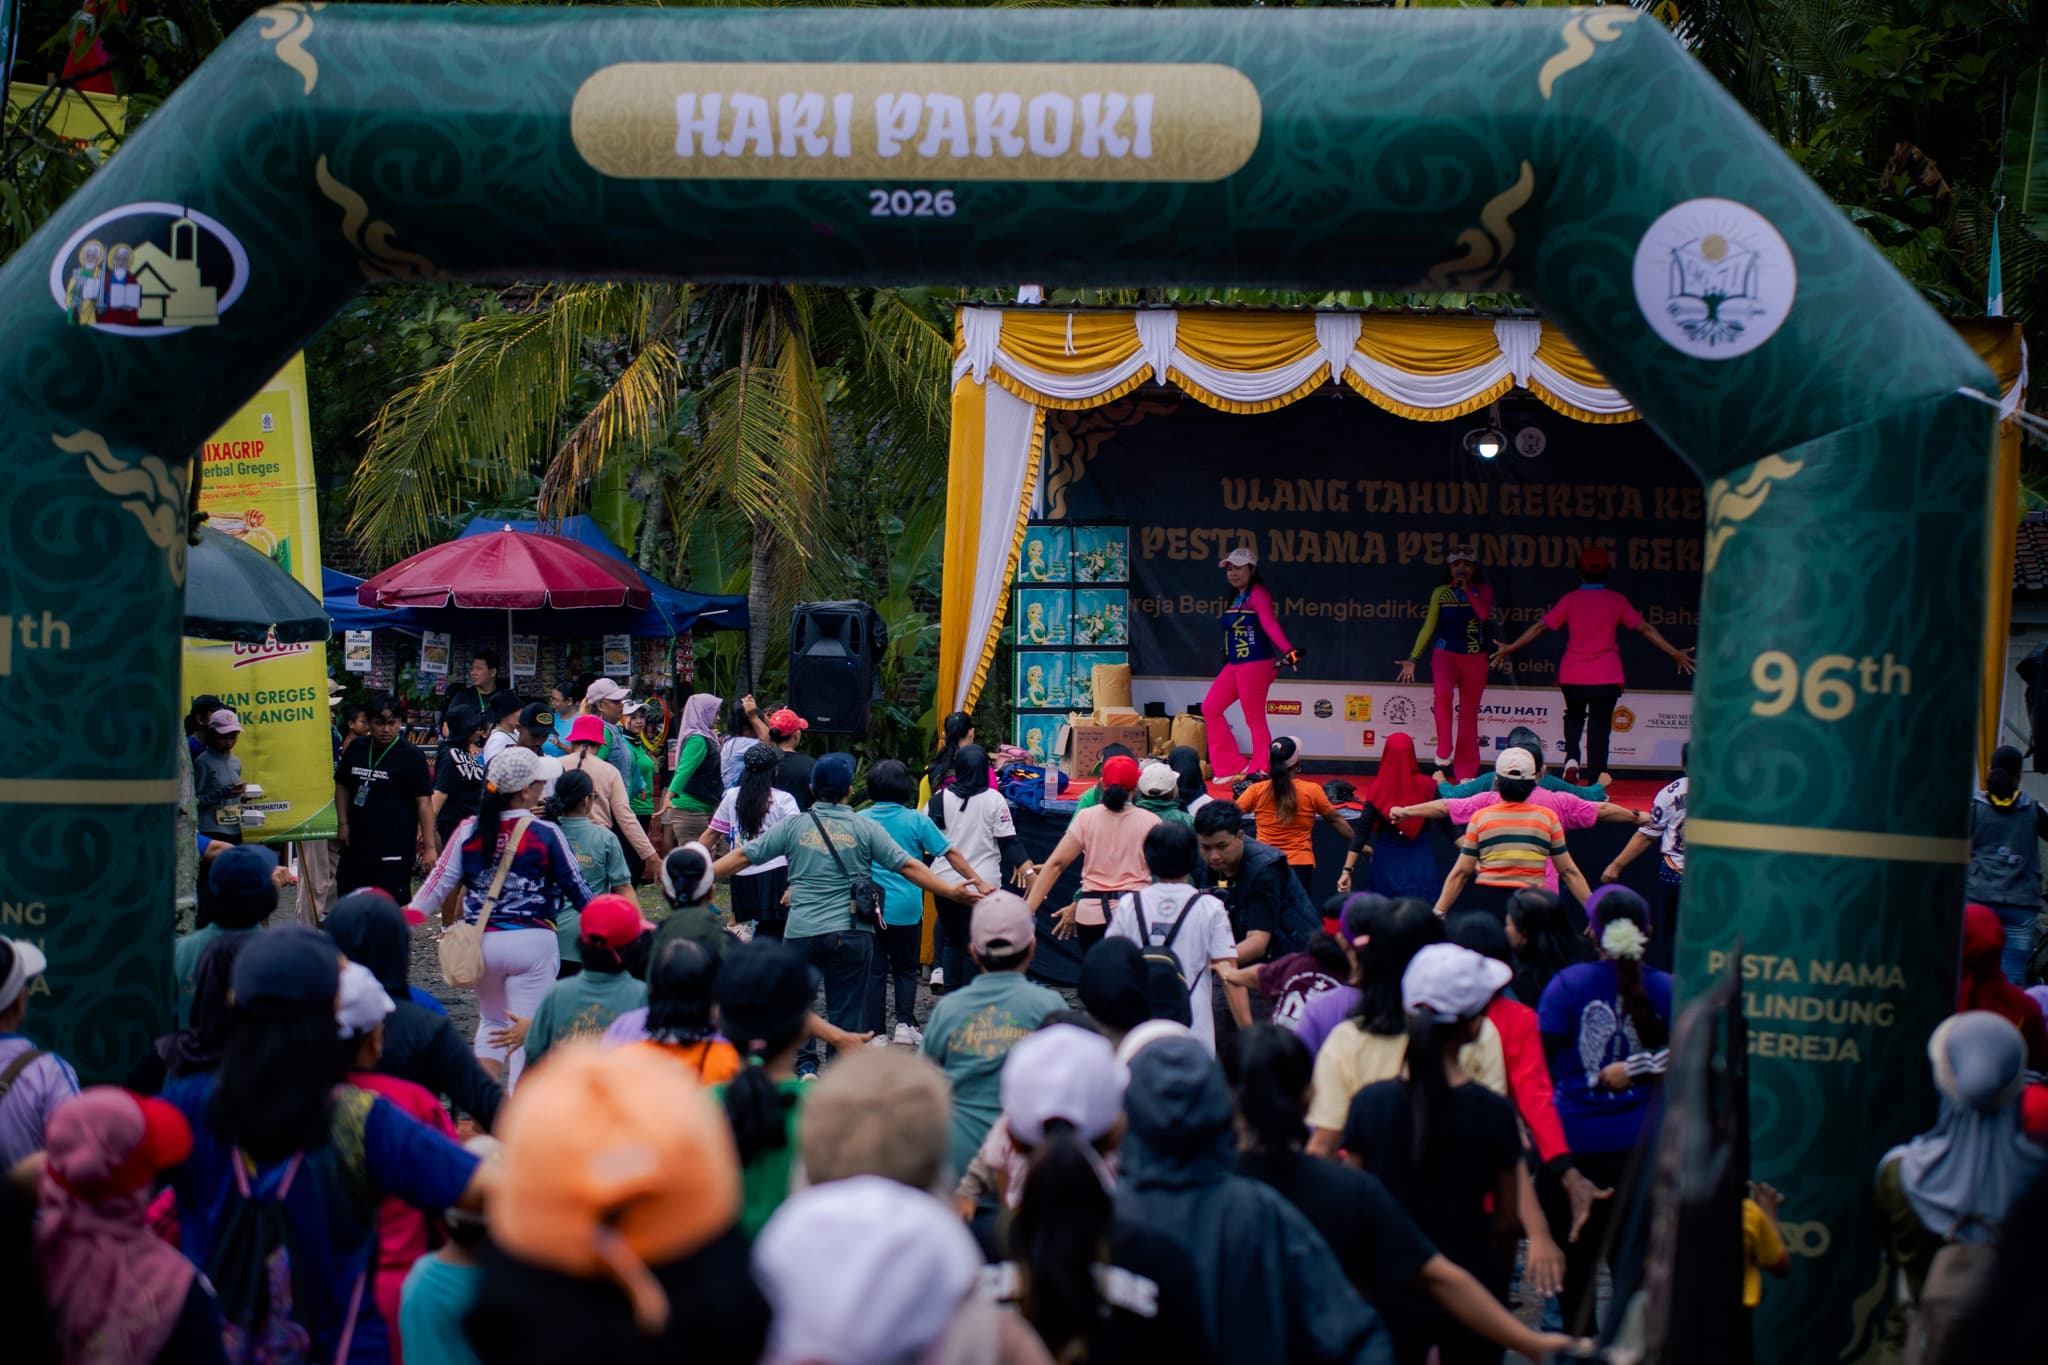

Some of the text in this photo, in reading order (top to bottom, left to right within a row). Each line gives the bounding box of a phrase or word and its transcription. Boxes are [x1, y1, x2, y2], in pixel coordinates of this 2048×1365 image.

[674, 92, 1155, 160] HARI PAROKI
[869, 189, 958, 218] 2026
[202, 462, 280, 479] erbal Greges
[1221, 477, 1349, 513] ULANG
[1357, 479, 1489, 515] TAHUN
[1499, 482, 1644, 521] GEREJA
[1141, 527, 1259, 561] PESTA
[1268, 528, 1387, 565] NAMA
[1284, 595, 1432, 622] Menghadirka
[1518, 656, 1556, 674] oleh
[255, 686, 317, 706] GREGES
[1750, 649, 1912, 722] 96th
[257, 706, 315, 725] ANGIN
[1478, 705, 1549, 717] SATU HATI
[1707, 949, 1906, 990] PSTA NAMA
[1743, 991, 1897, 1029] LINDUNG
